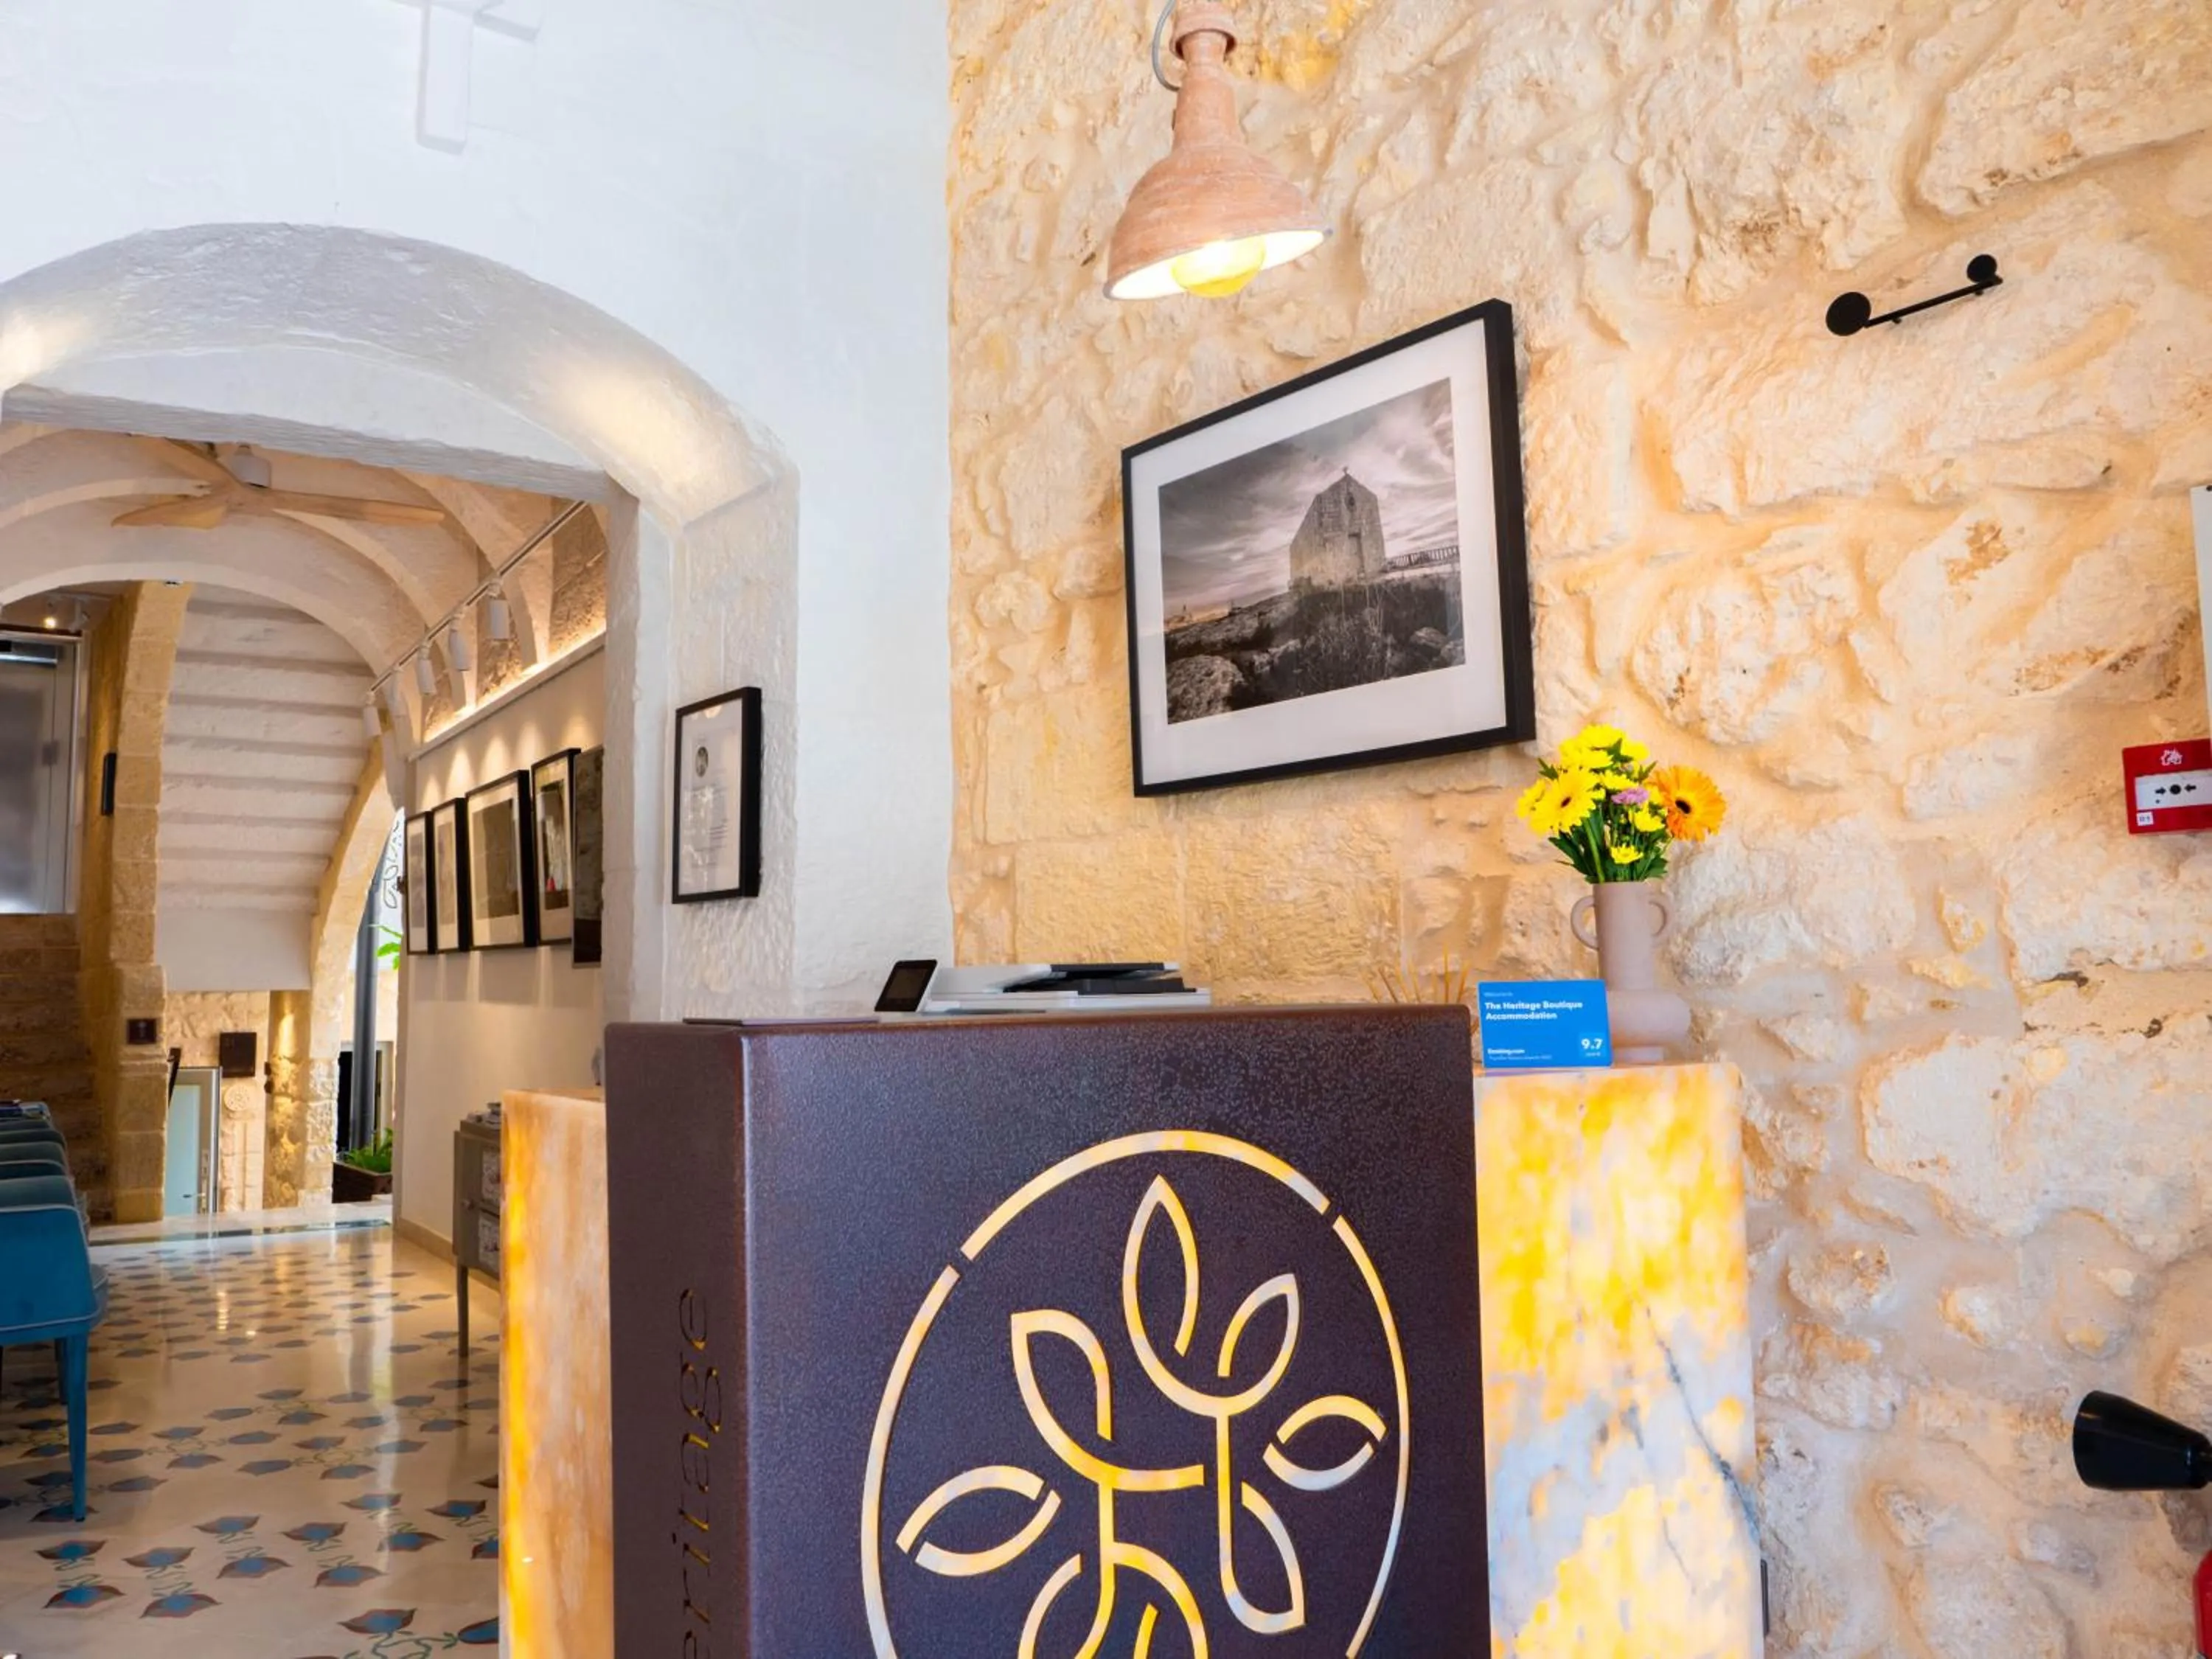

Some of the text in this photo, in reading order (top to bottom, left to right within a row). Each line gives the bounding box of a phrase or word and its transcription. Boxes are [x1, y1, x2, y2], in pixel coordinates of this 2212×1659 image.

[1503, 1001, 1540, 1011] Heritage
[1543, 1000, 1583, 1011] Boutique
[1486, 1011, 1557, 1020] Accommodation
[1582, 1038, 1603, 1050] 9.7
